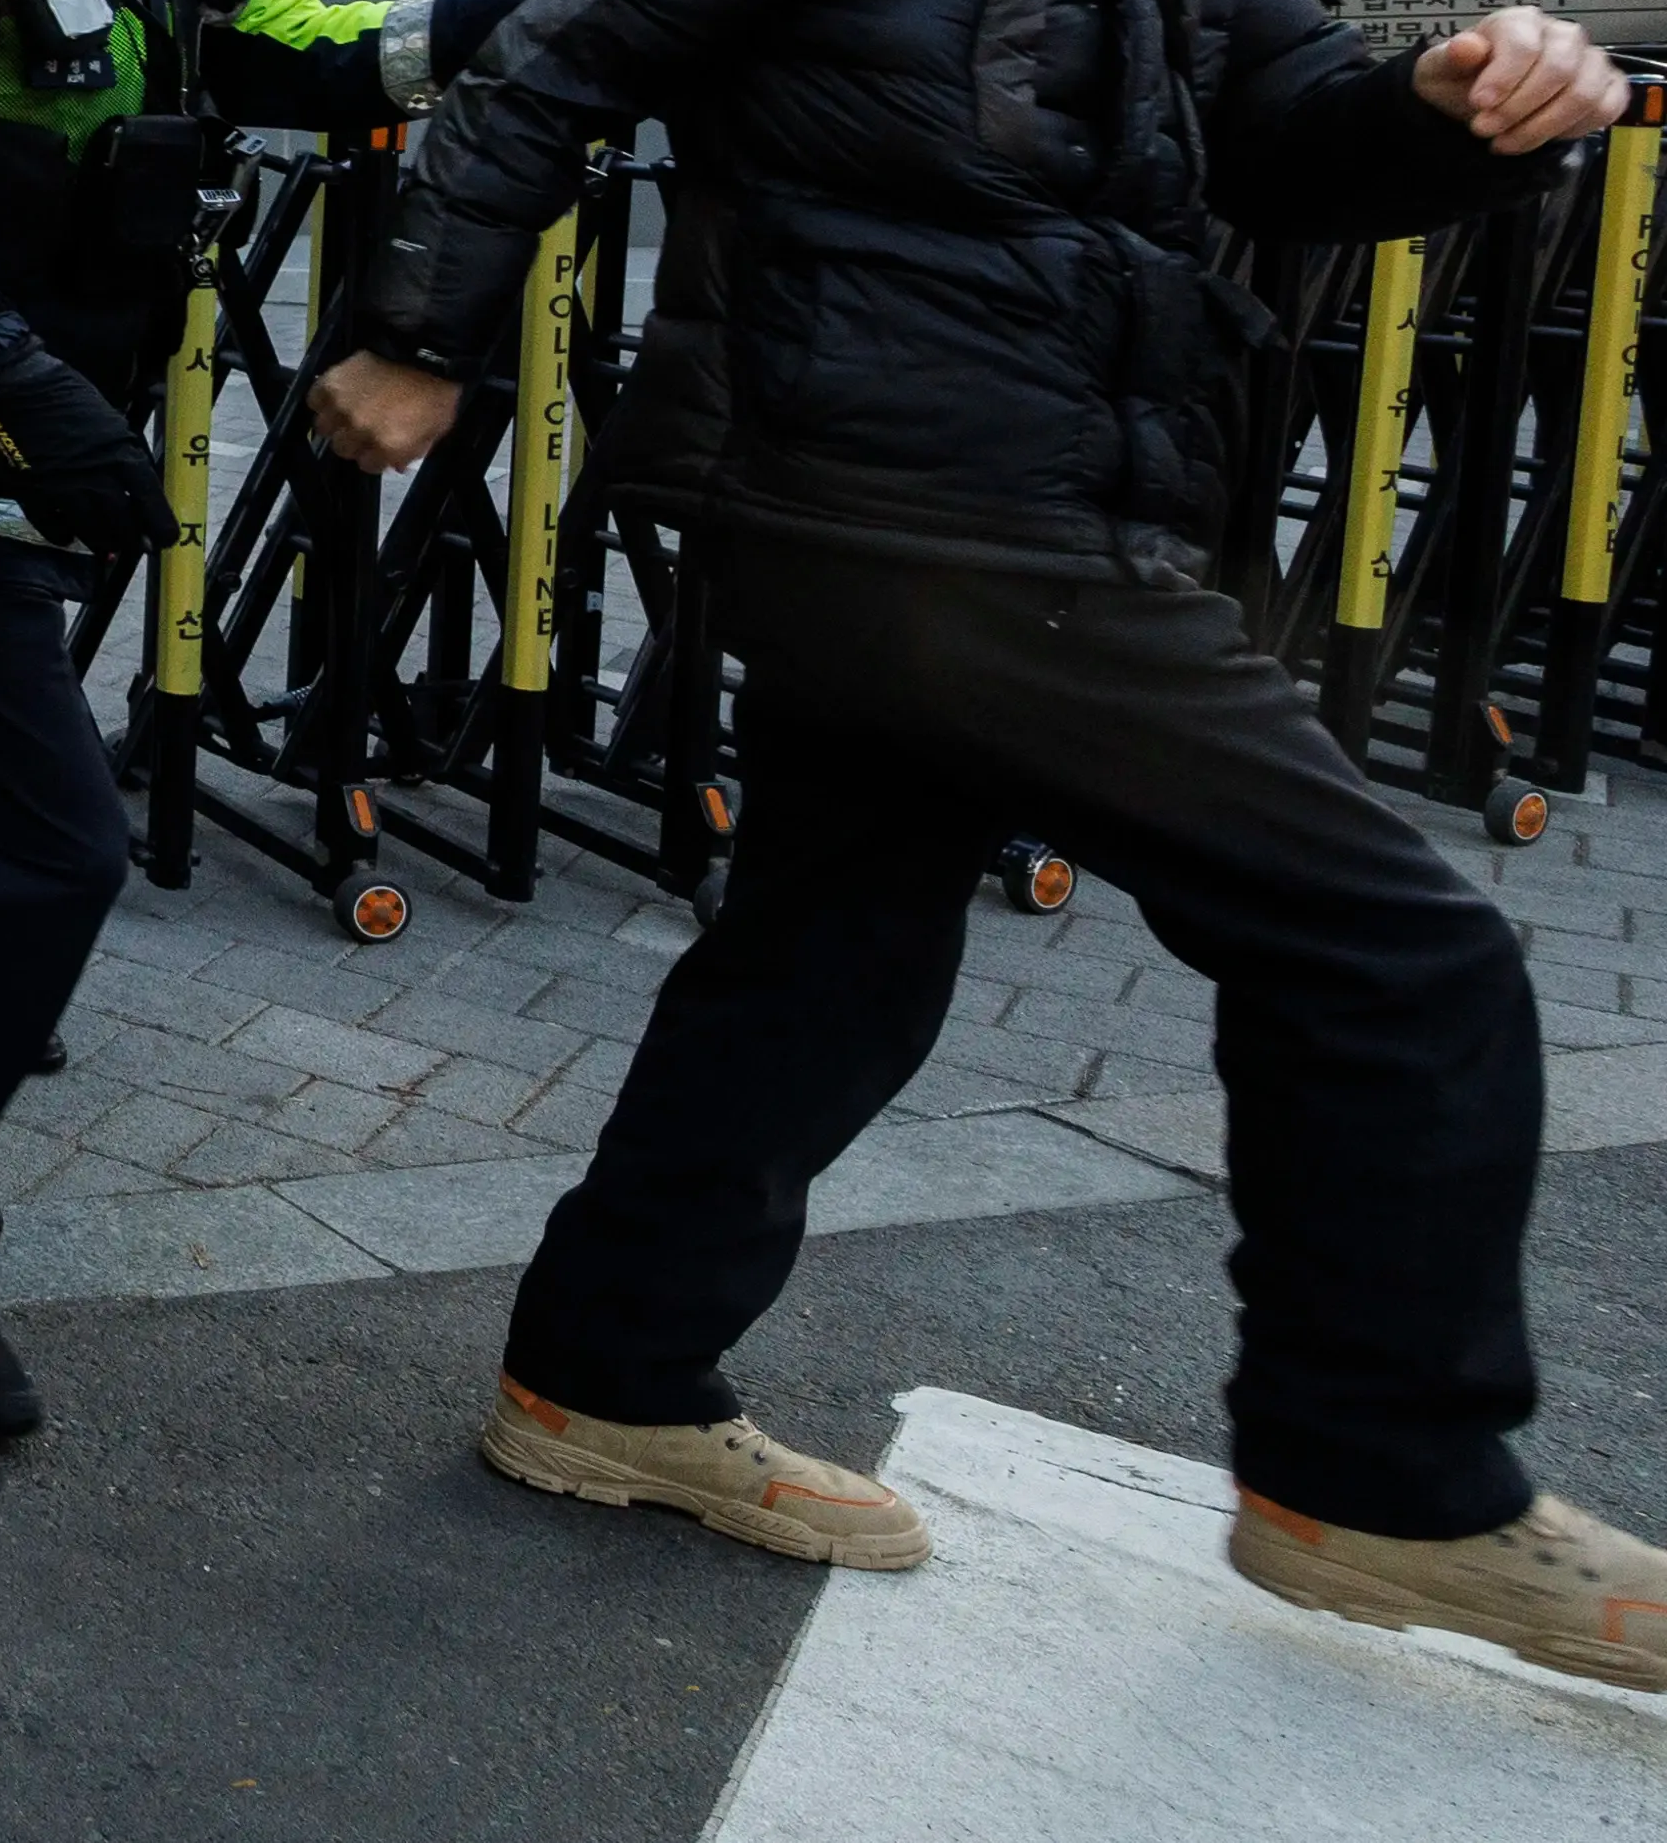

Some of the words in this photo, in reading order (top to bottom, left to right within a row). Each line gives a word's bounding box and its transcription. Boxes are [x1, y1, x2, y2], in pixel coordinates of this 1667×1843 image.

[1363, 19, 1460, 45] 법무사
[543, 254, 573, 461] POLICE
[535, 503, 557, 636] LINE
